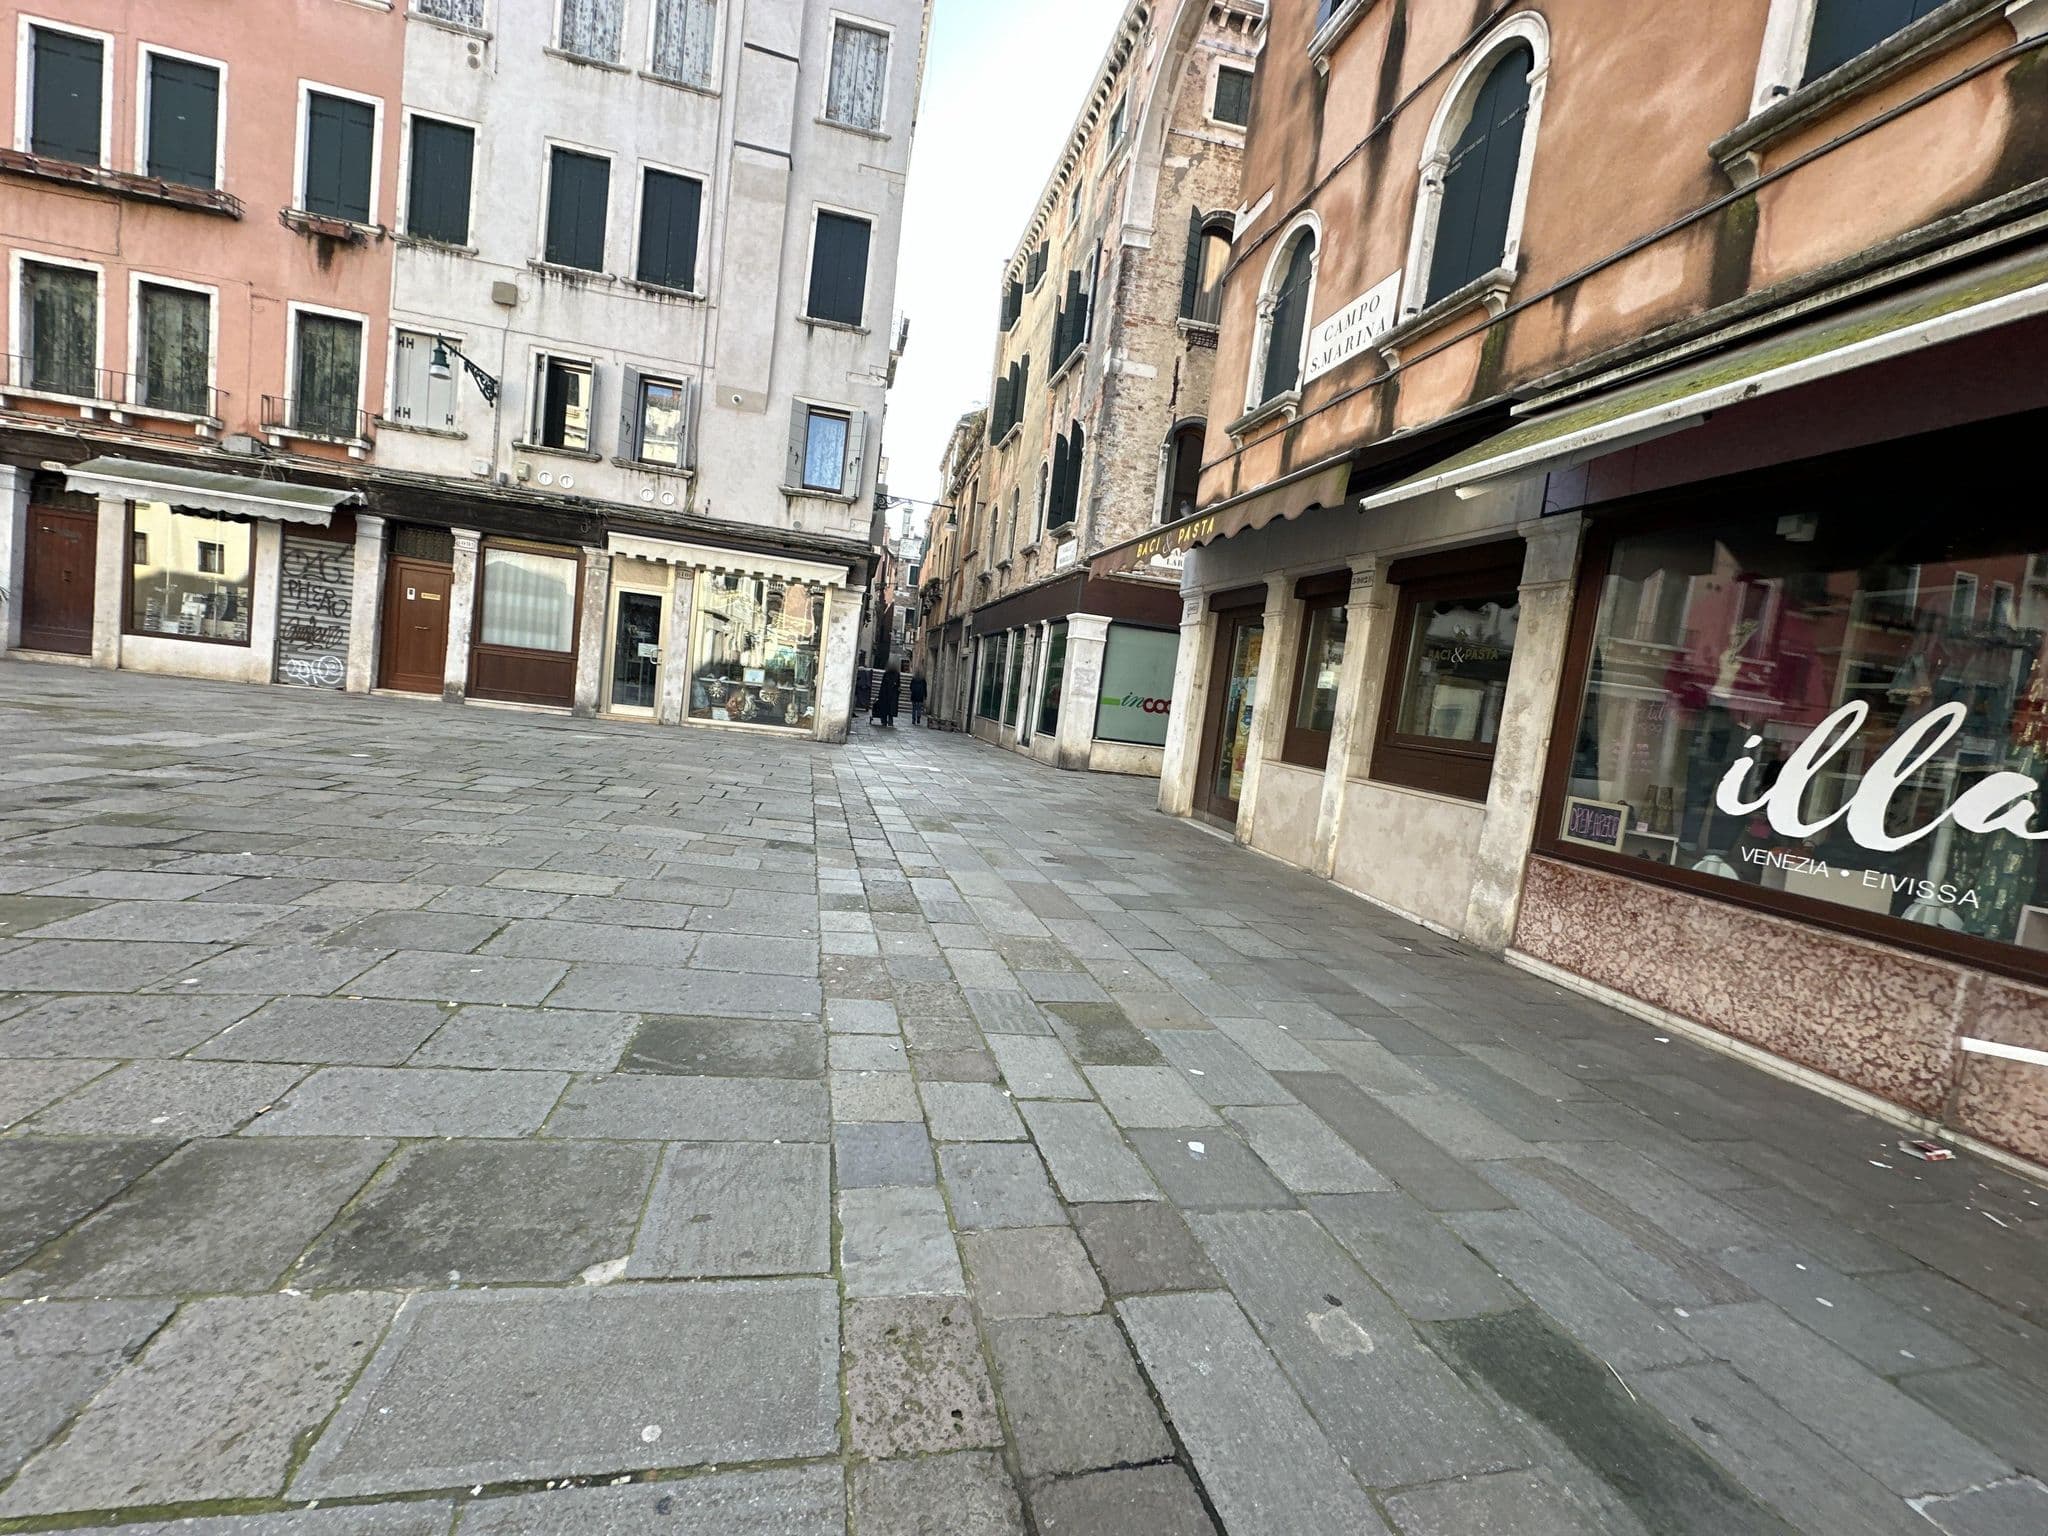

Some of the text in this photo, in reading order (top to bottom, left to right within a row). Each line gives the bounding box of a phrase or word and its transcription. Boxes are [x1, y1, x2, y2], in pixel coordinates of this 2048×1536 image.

[1324, 294, 1381, 342] CAMPO
[1136, 537, 1161, 558] BACI
[1177, 517, 1215, 544] PASTA
[1741, 846, 1980, 909] VENEZIA EIVISSA
